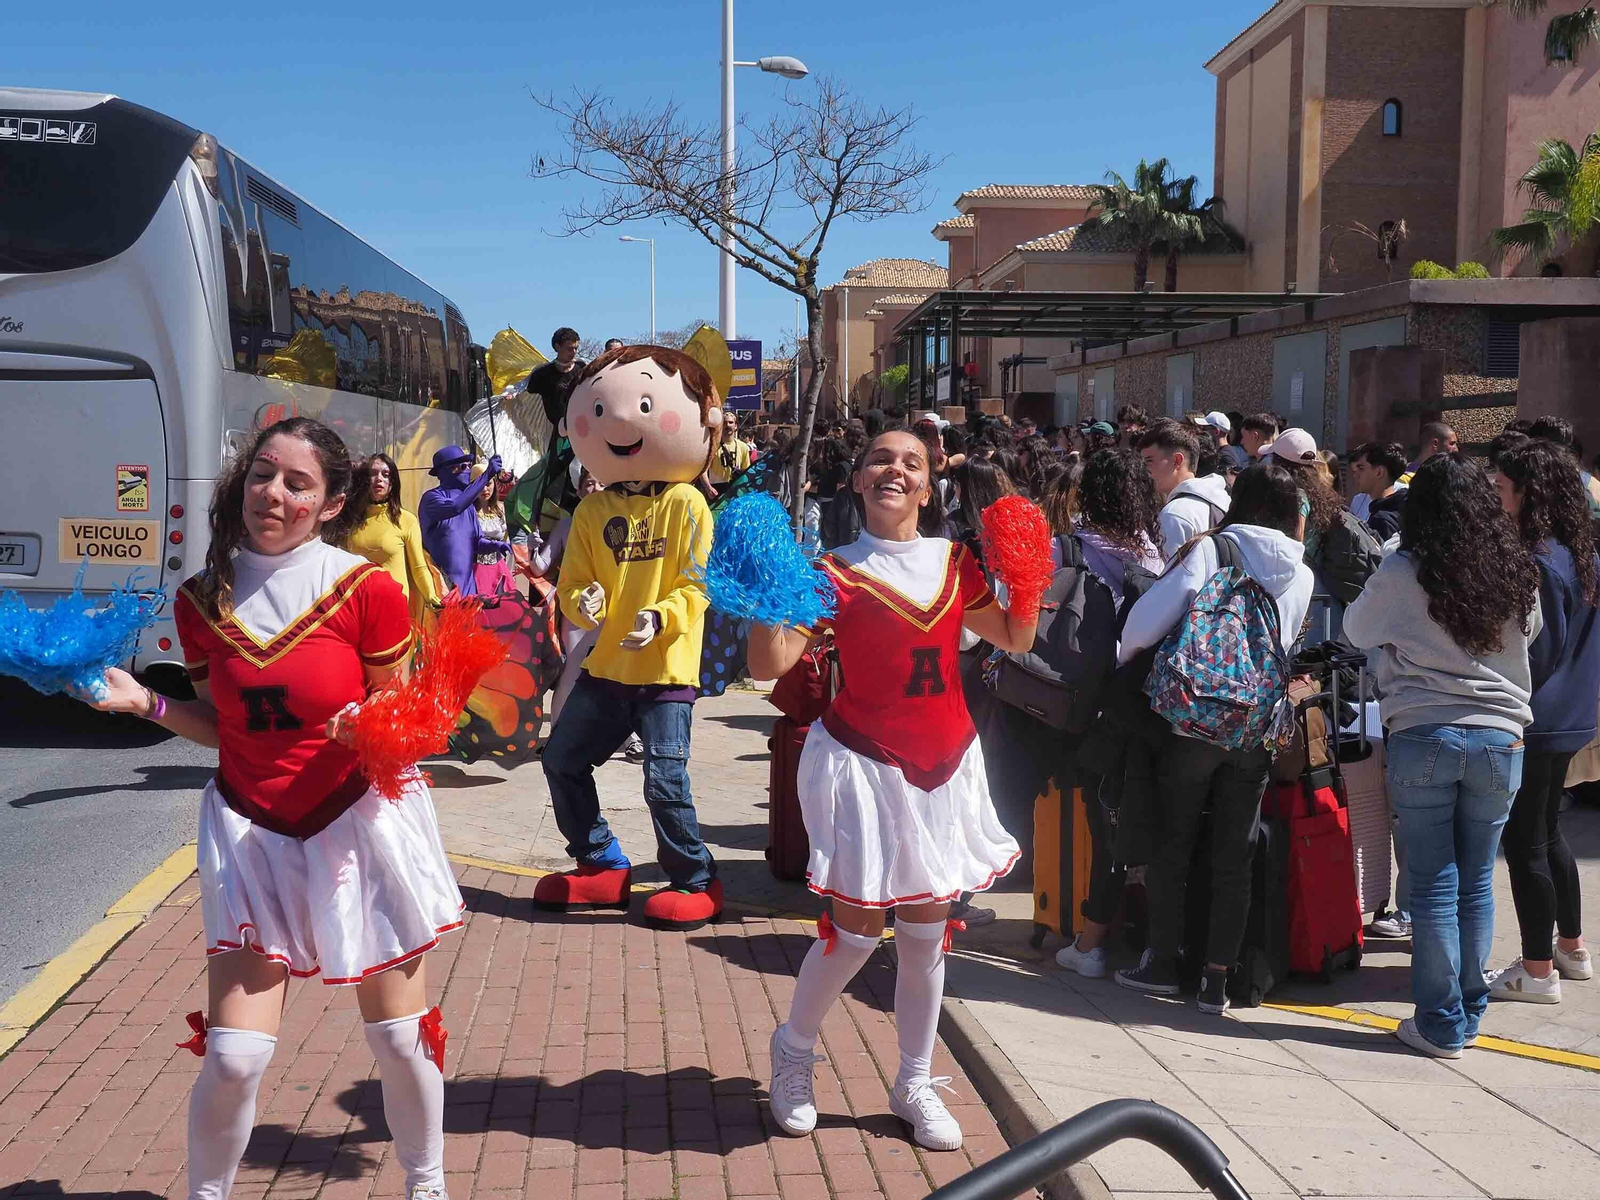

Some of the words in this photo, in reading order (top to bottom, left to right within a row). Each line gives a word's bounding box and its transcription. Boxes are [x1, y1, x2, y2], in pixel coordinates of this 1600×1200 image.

[71, 525, 148, 541] VEICULO
[76, 542, 142, 558] LONGO
[904, 646, 947, 697] A
[240, 686, 303, 732] A
